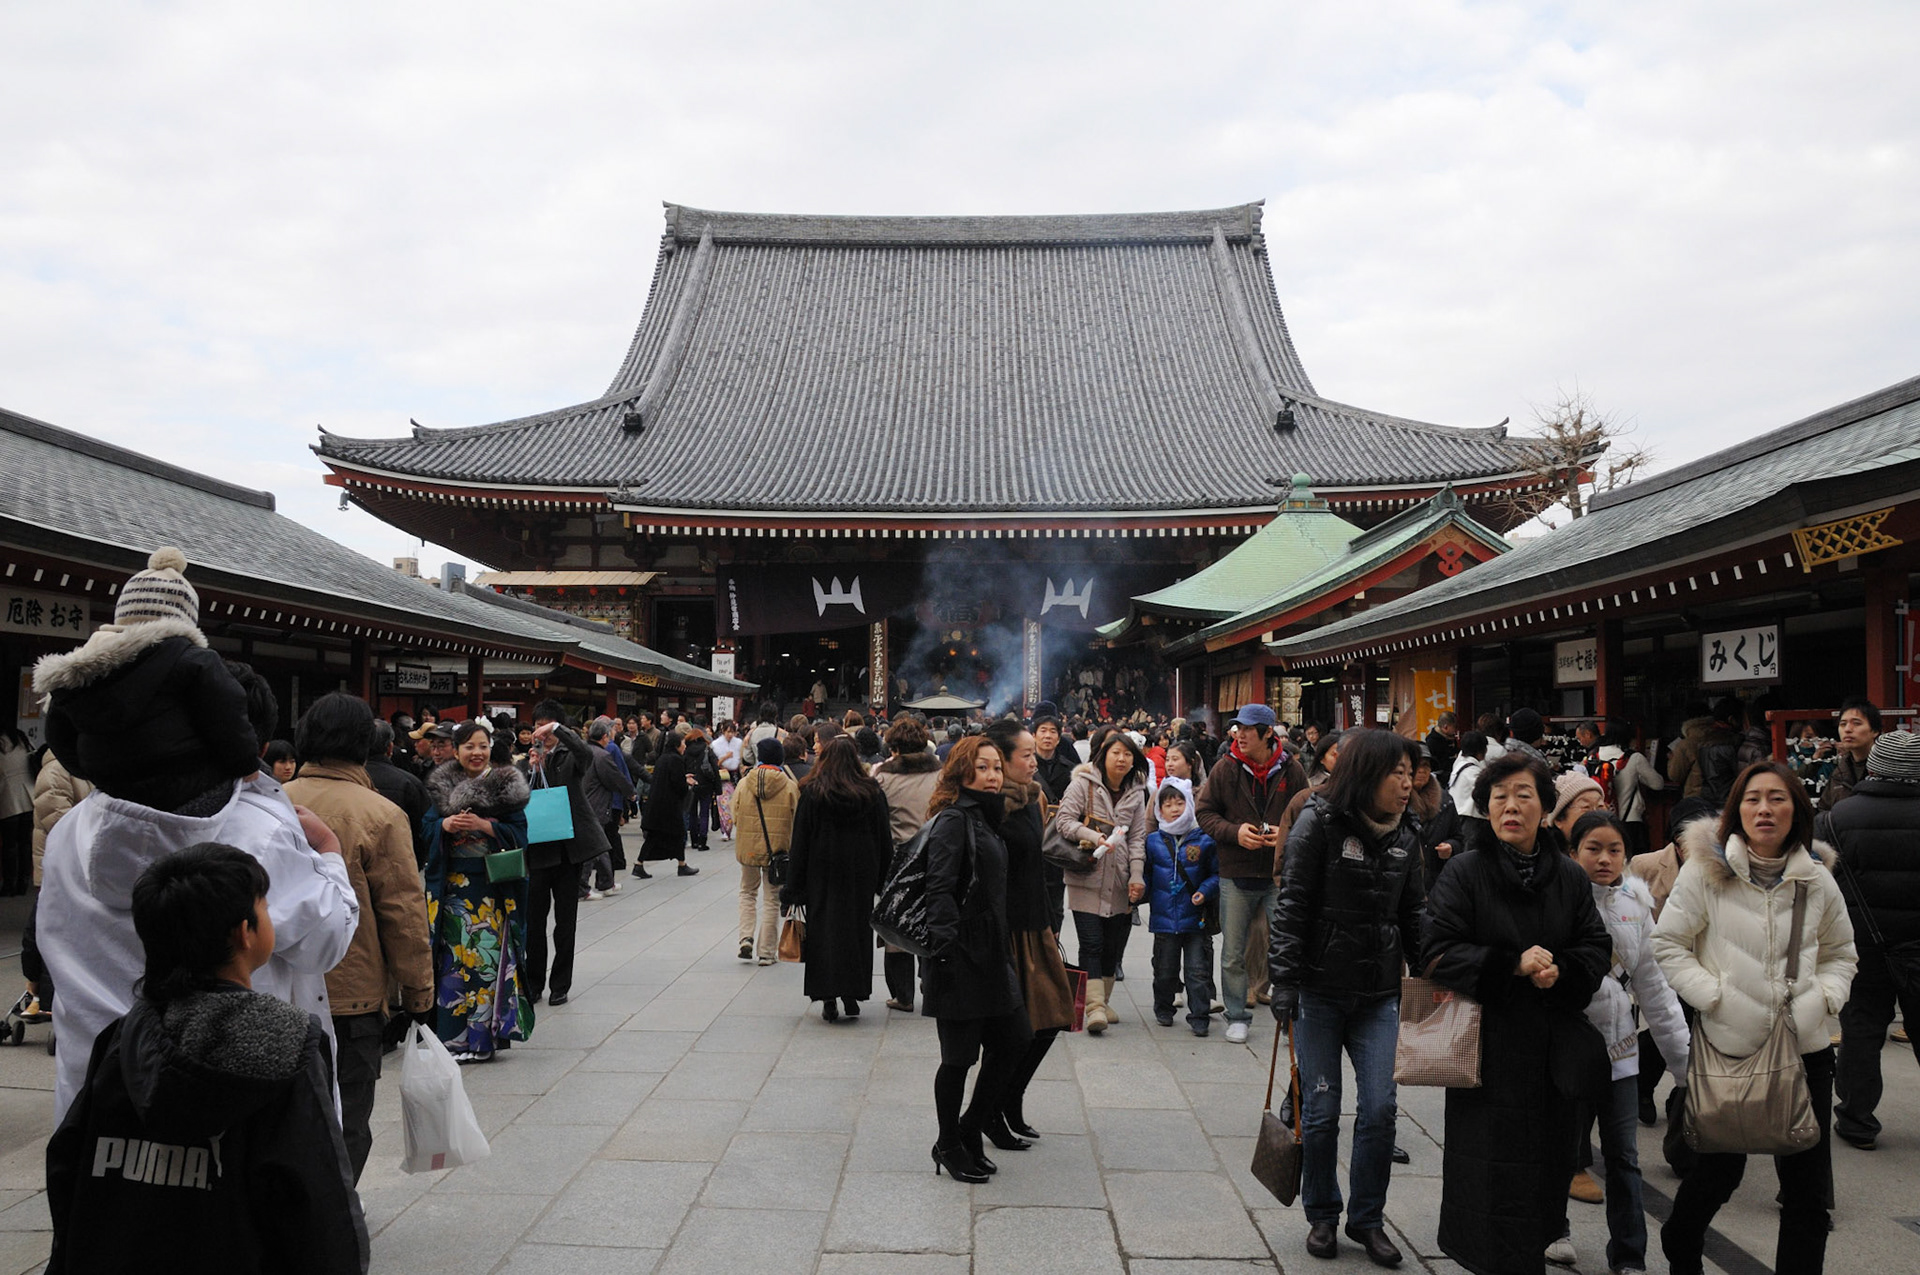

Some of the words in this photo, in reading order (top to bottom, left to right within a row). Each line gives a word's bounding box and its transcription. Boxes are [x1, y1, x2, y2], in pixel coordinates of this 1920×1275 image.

[1710, 632, 1775, 672] みくじ
[92, 1136, 210, 1190] PUMA
